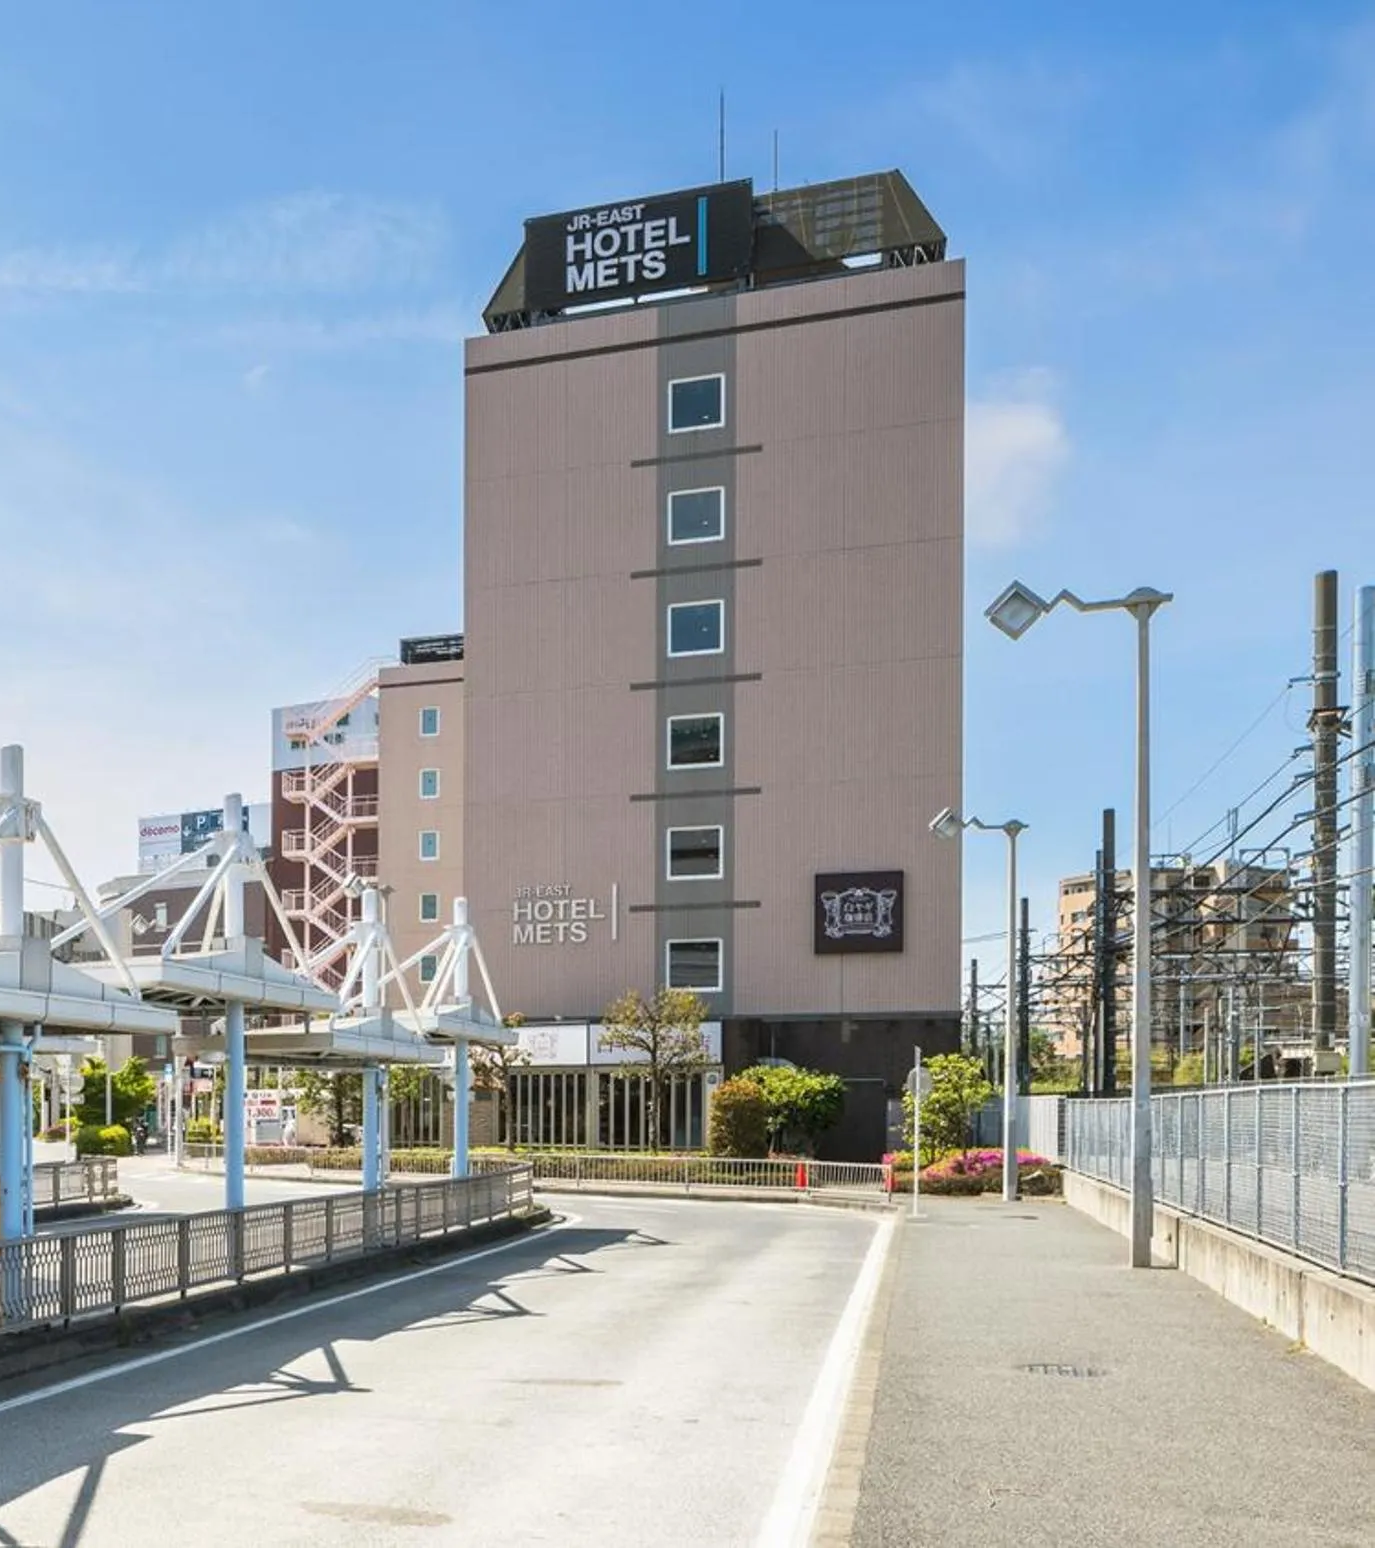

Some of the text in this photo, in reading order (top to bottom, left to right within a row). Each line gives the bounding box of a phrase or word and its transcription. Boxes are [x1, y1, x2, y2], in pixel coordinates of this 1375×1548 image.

[567, 203, 645, 232] JR-EAST
[567, 216, 691, 263] HOTEL
[567, 250, 666, 293] METS
[513, 899, 605, 921] HOTEL
[513, 922, 587, 944] METS
